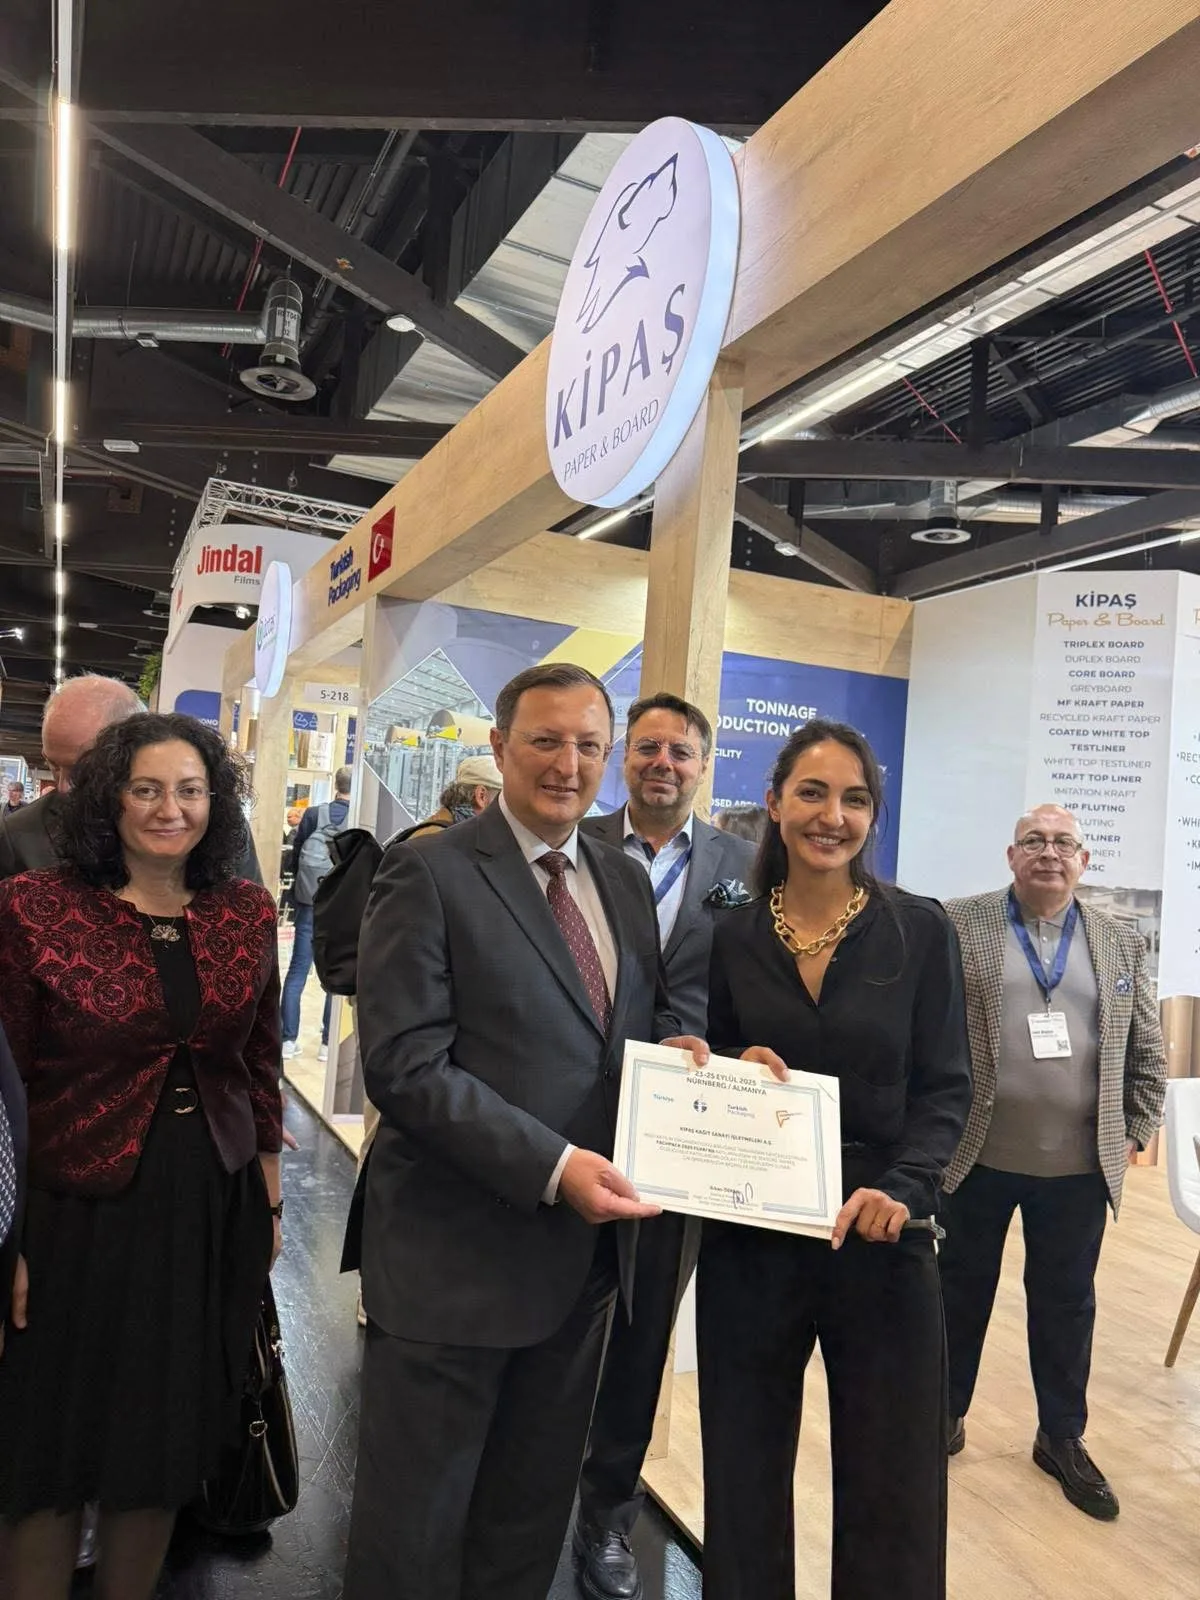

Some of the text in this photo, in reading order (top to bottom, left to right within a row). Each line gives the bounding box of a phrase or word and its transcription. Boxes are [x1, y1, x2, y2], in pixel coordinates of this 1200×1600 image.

[553, 283, 686, 449] KİPAŞ
[563, 399, 660, 482] PAPER & BOARD
[197, 544, 263, 576] Jindal
[330, 545, 354, 582] Turkish
[234, 574, 261, 586] Films
[328, 567, 362, 608] Packaging
[1075, 590, 1137, 610] KİPAŞ
[1046, 612, 1166, 631] Paper & Board
[1063, 640, 1145, 649] TRIPLEX BOARD
[1065, 655, 1141, 664] DUPLEX BOARD
[1068, 670, 1136, 678] CORE BOARD
[1070, 684, 1133, 694] GREYBOARD
[320, 690, 349, 702] S-218
[746, 698, 818, 720] TONNAGE
[1057, 699, 1145, 709] MF KRAFT PAPER
[1039, 713, 1161, 724] RECYCLED KRAFT PAPER
[1049, 728, 1150, 739] COATED WHITE TOP
[1070, 743, 1126, 752] TESTLINER
[1043, 757, 1152, 769] WHITE TOP TESTLINER
[1051, 772, 1142, 784] KRAFT TOP LINER
[1054, 787, 1137, 798] IMITATION KRAFT
[1064, 803, 1126, 813] HP FLUTING
[695, 1070, 757, 1087] 23-25 EYLÜL 2025
[686, 1077, 727, 1089] NÜRNBERG
[732, 1085, 767, 1096] ALMANYA
